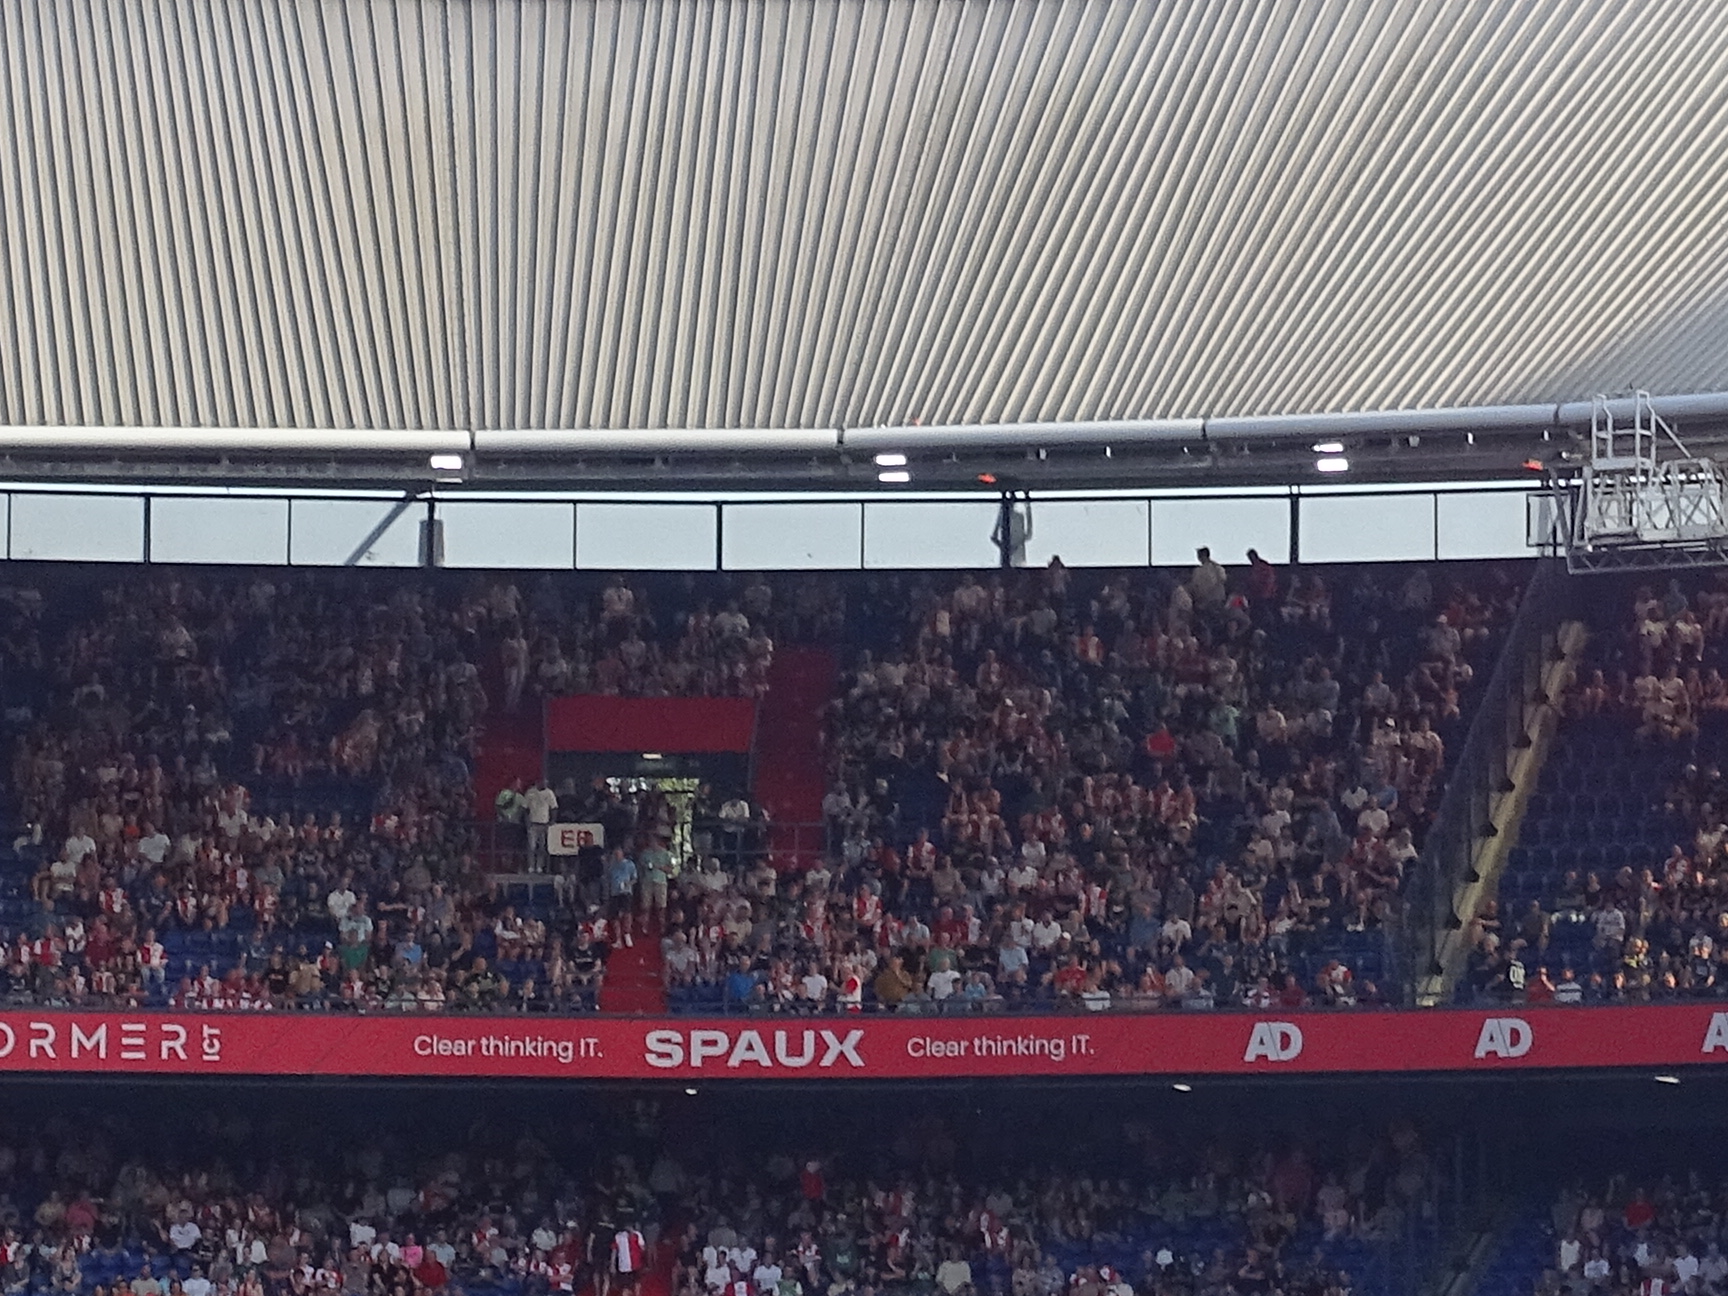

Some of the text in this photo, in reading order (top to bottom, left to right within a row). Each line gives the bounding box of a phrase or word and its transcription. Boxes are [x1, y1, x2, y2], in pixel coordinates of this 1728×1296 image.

[413, 1034, 604, 1064] Clear thinking IT.
[644, 1029, 865, 1068] SPAUX
[907, 1034, 1096, 1062] Clear thinking IT.
[1243, 1021, 1303, 1062] AD
[1474, 1017, 1533, 1059] AD
